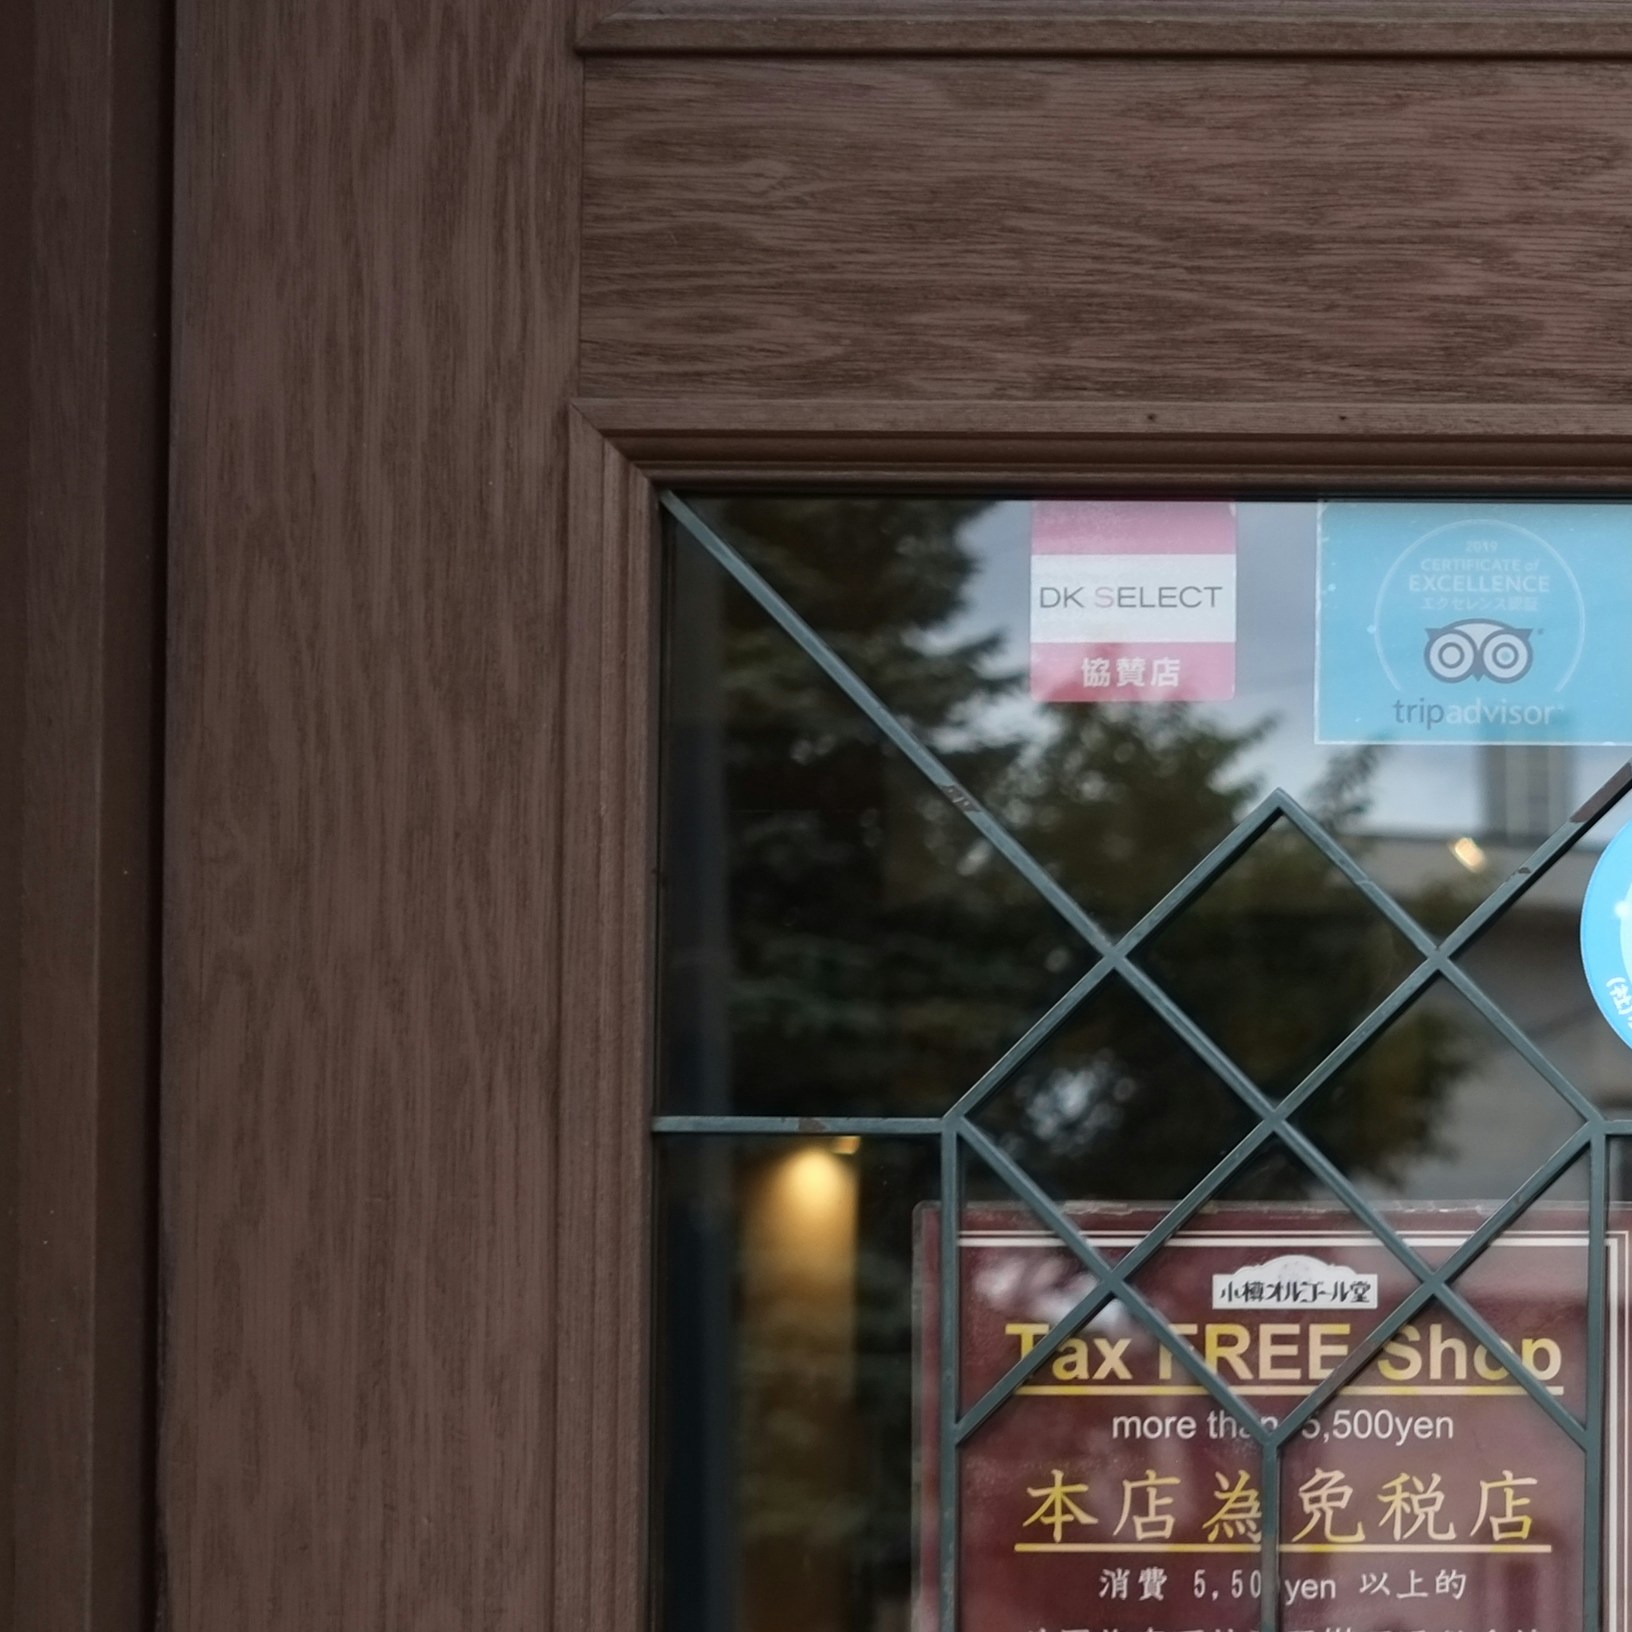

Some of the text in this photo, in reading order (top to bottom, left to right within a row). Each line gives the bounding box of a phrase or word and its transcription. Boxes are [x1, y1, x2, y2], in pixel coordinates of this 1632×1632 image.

[1420, 558, 1540, 572] CERTIFICATE of
[1408, 574, 1551, 593] EXCELLENCE
[1040, 586, 1223, 608] DK SELECT
[1081, 657, 1181, 688] 協賛店
[1393, 698, 1554, 729] tripadvisor
[1220, 1280, 1371, 1303] 小樽オルゴール堂
[1005, 1323, 1563, 1383] Tax FREE Shop
[1112, 1415, 1197, 1439] more
[1099, 1567, 1468, 1605] 消費 5,50yen 以上的
